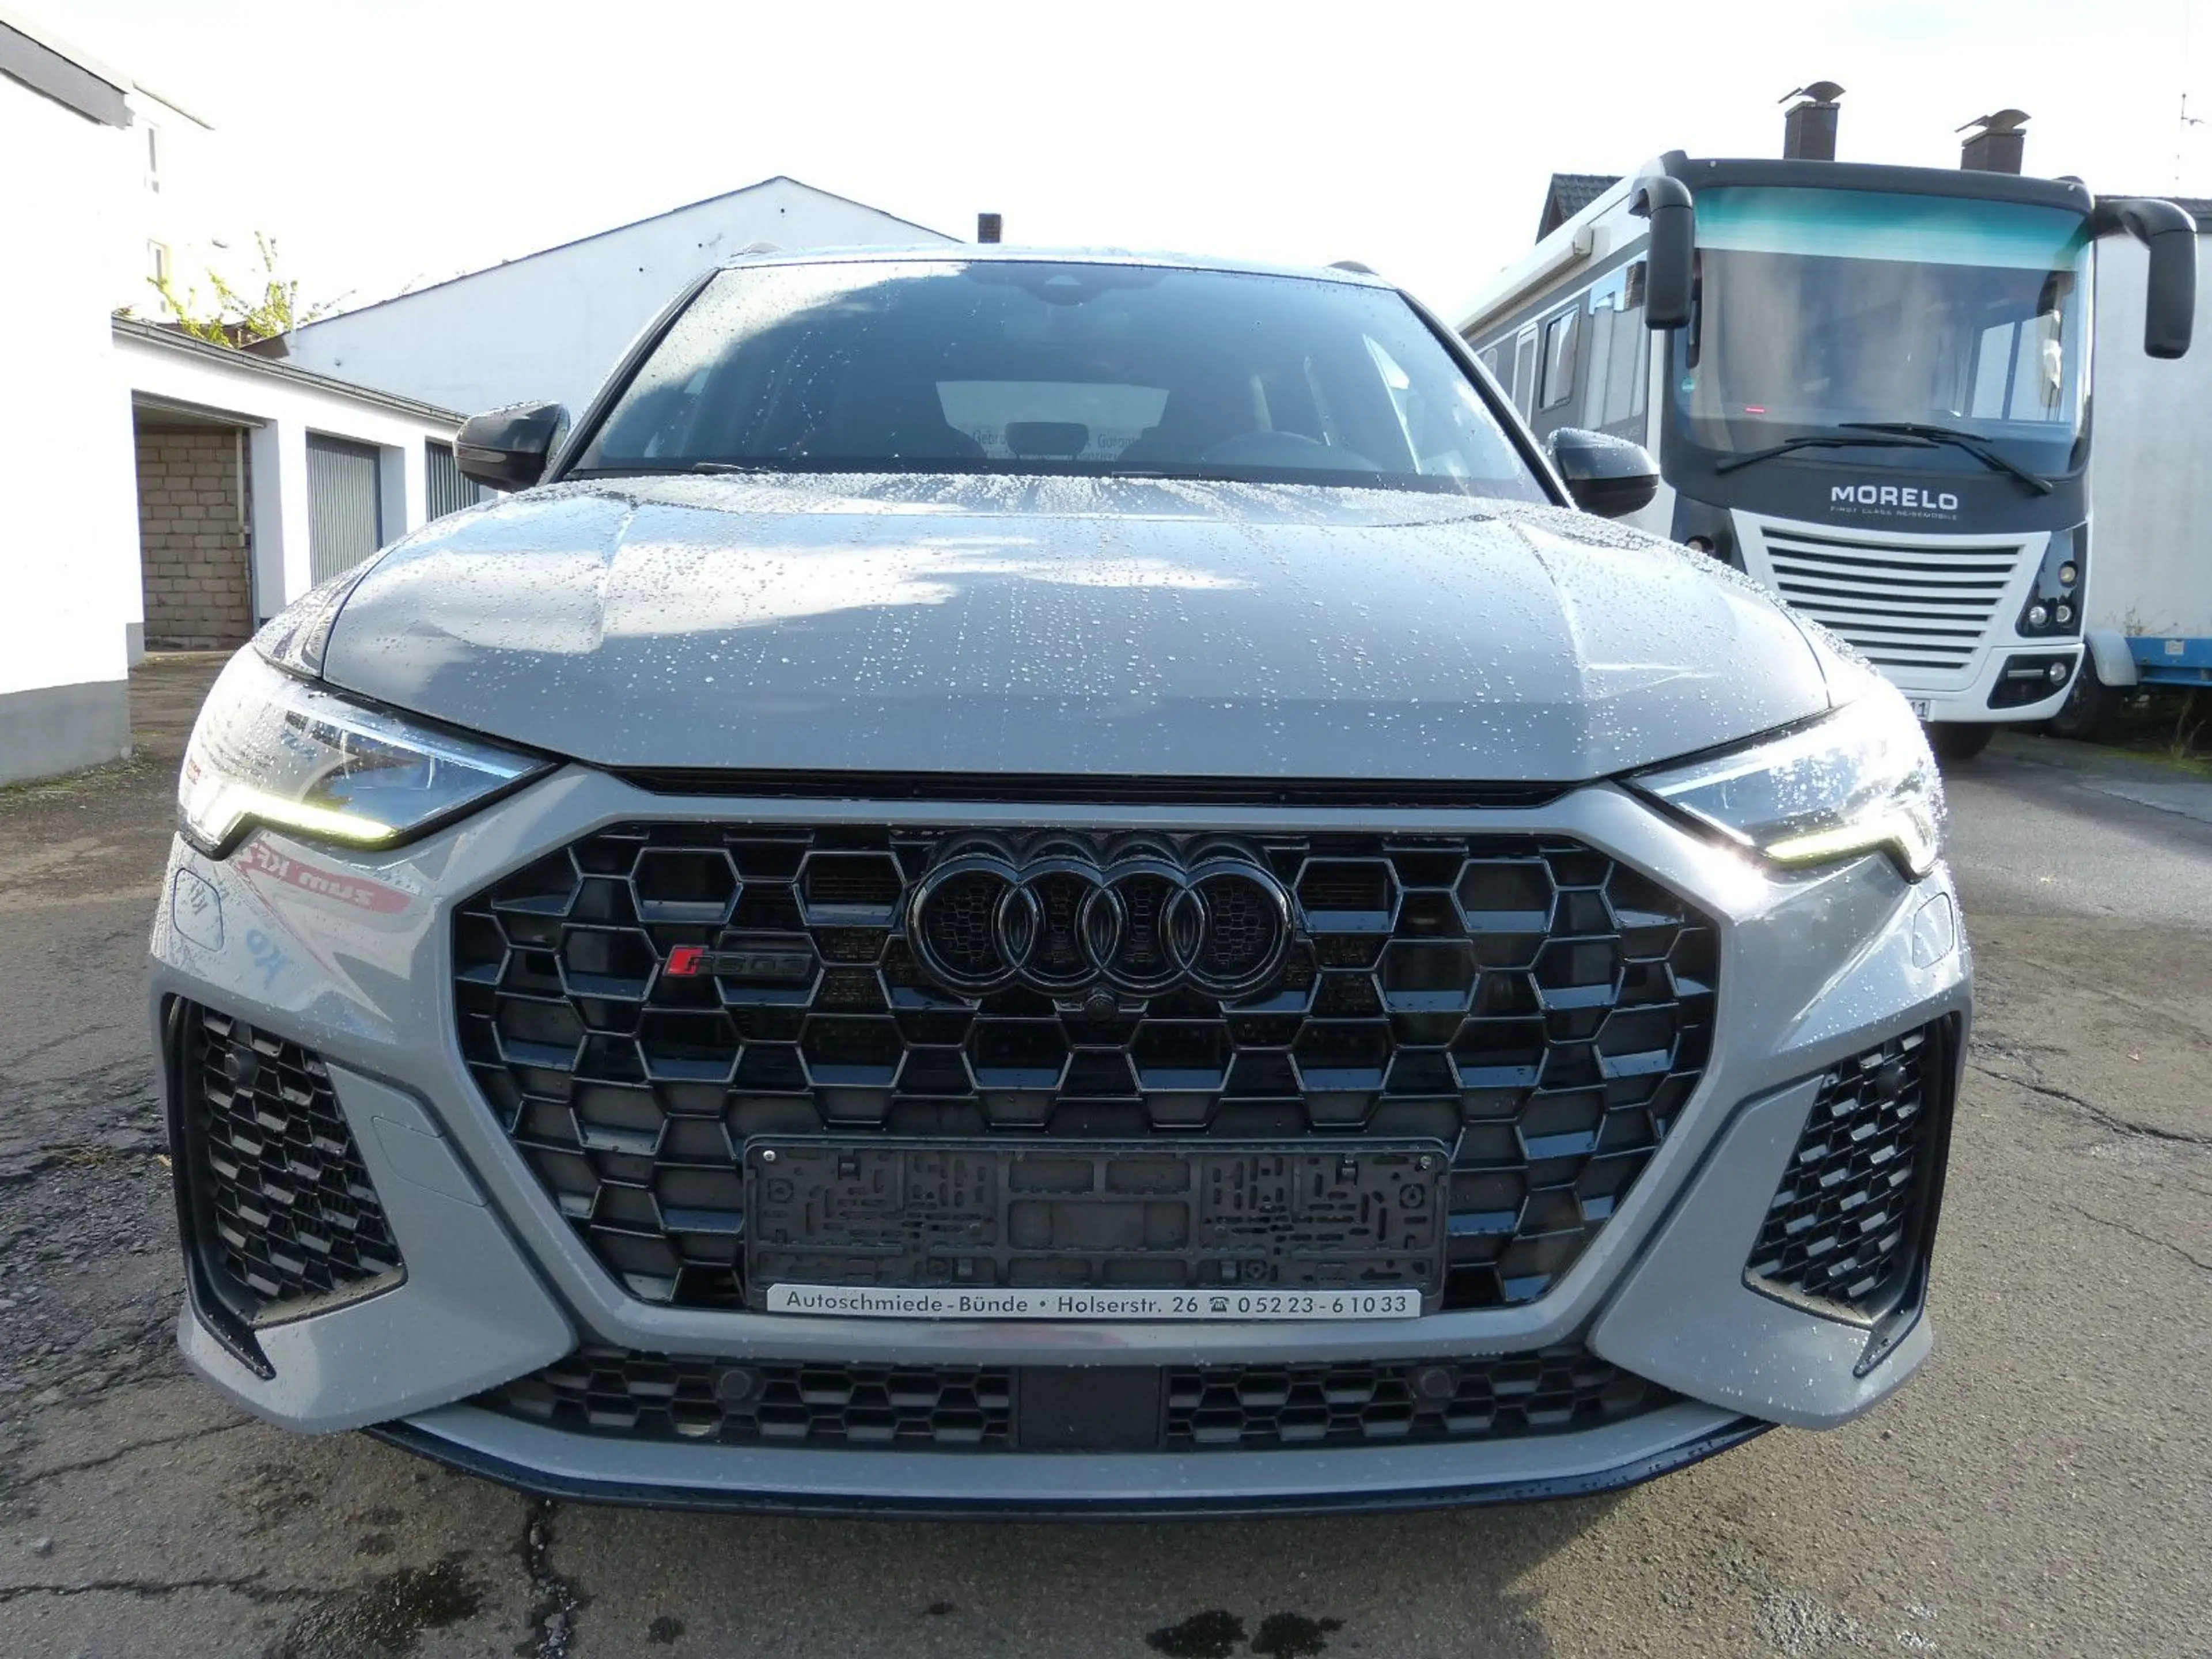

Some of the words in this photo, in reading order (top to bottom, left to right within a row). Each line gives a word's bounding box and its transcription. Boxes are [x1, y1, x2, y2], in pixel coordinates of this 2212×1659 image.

[1831, 486, 1957, 510] MORELO
[1058, 1296, 1162, 1313] Holserstr.
[1172, 1296, 1198, 1313] 26
